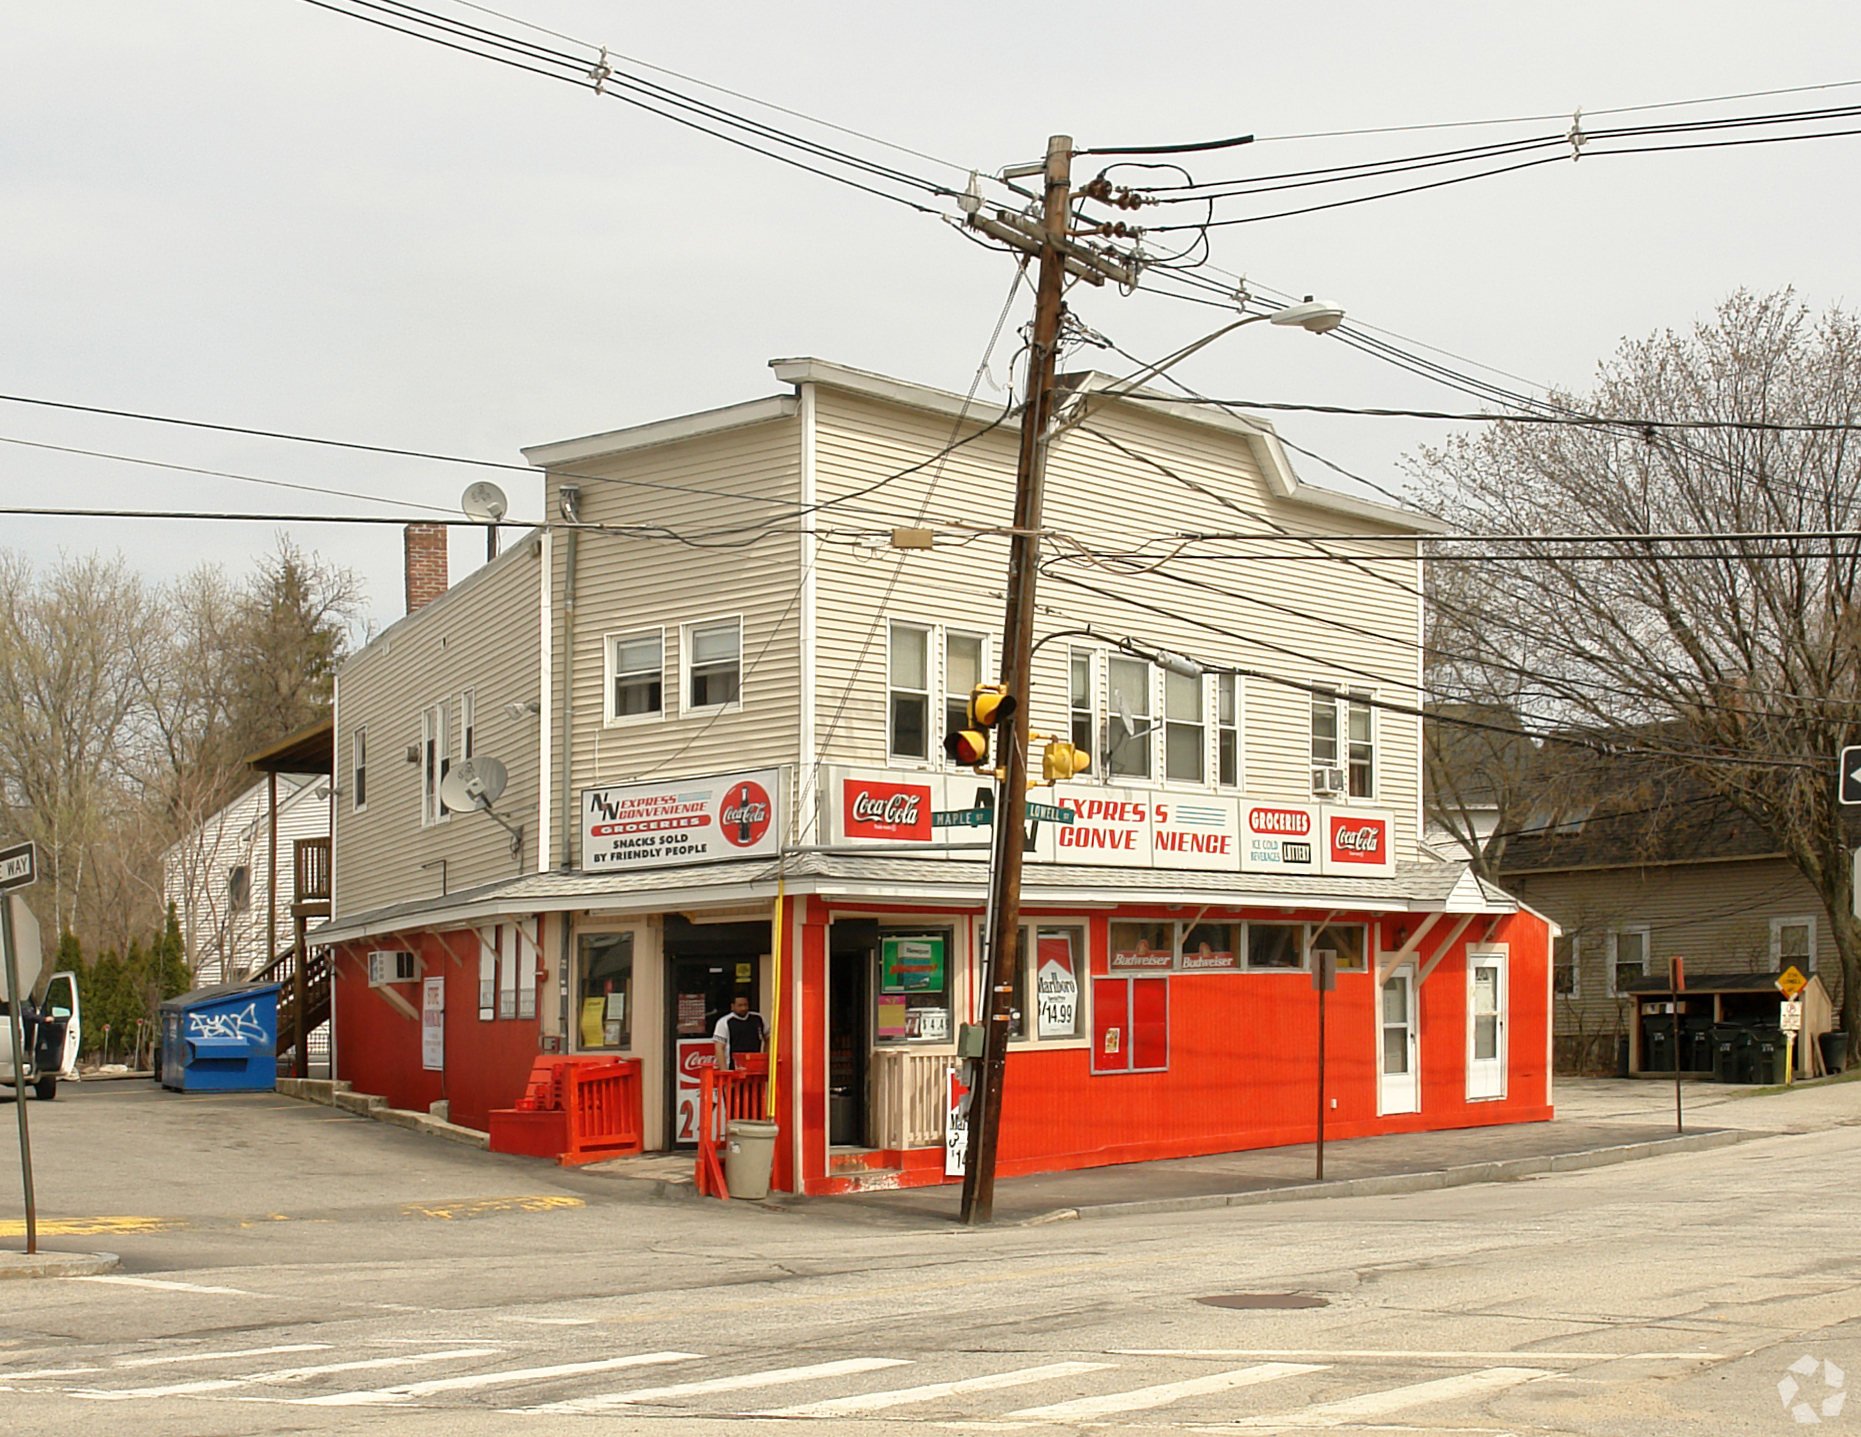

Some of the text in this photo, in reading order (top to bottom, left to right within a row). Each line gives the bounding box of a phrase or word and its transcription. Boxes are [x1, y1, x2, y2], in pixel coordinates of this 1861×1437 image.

[620, 794, 677, 809] EXPRESS
[618, 801, 709, 820] CONVENIENCE
[936, 812, 984, 826] MAPLE ST
[1030, 804, 1070, 821] LOWELL ST
[600, 817, 700, 834] GROCERIES
[1251, 811, 1308, 832] GROCERIES
[612, 833, 689, 849] SNACKS SOLD
[593, 843, 707, 863] BY FRIENDLY PEOPLE
[7, 856, 28, 876] WAY
[1112, 953, 1171, 966] Budweiser
[1182, 956, 1234, 968] Budweiser
